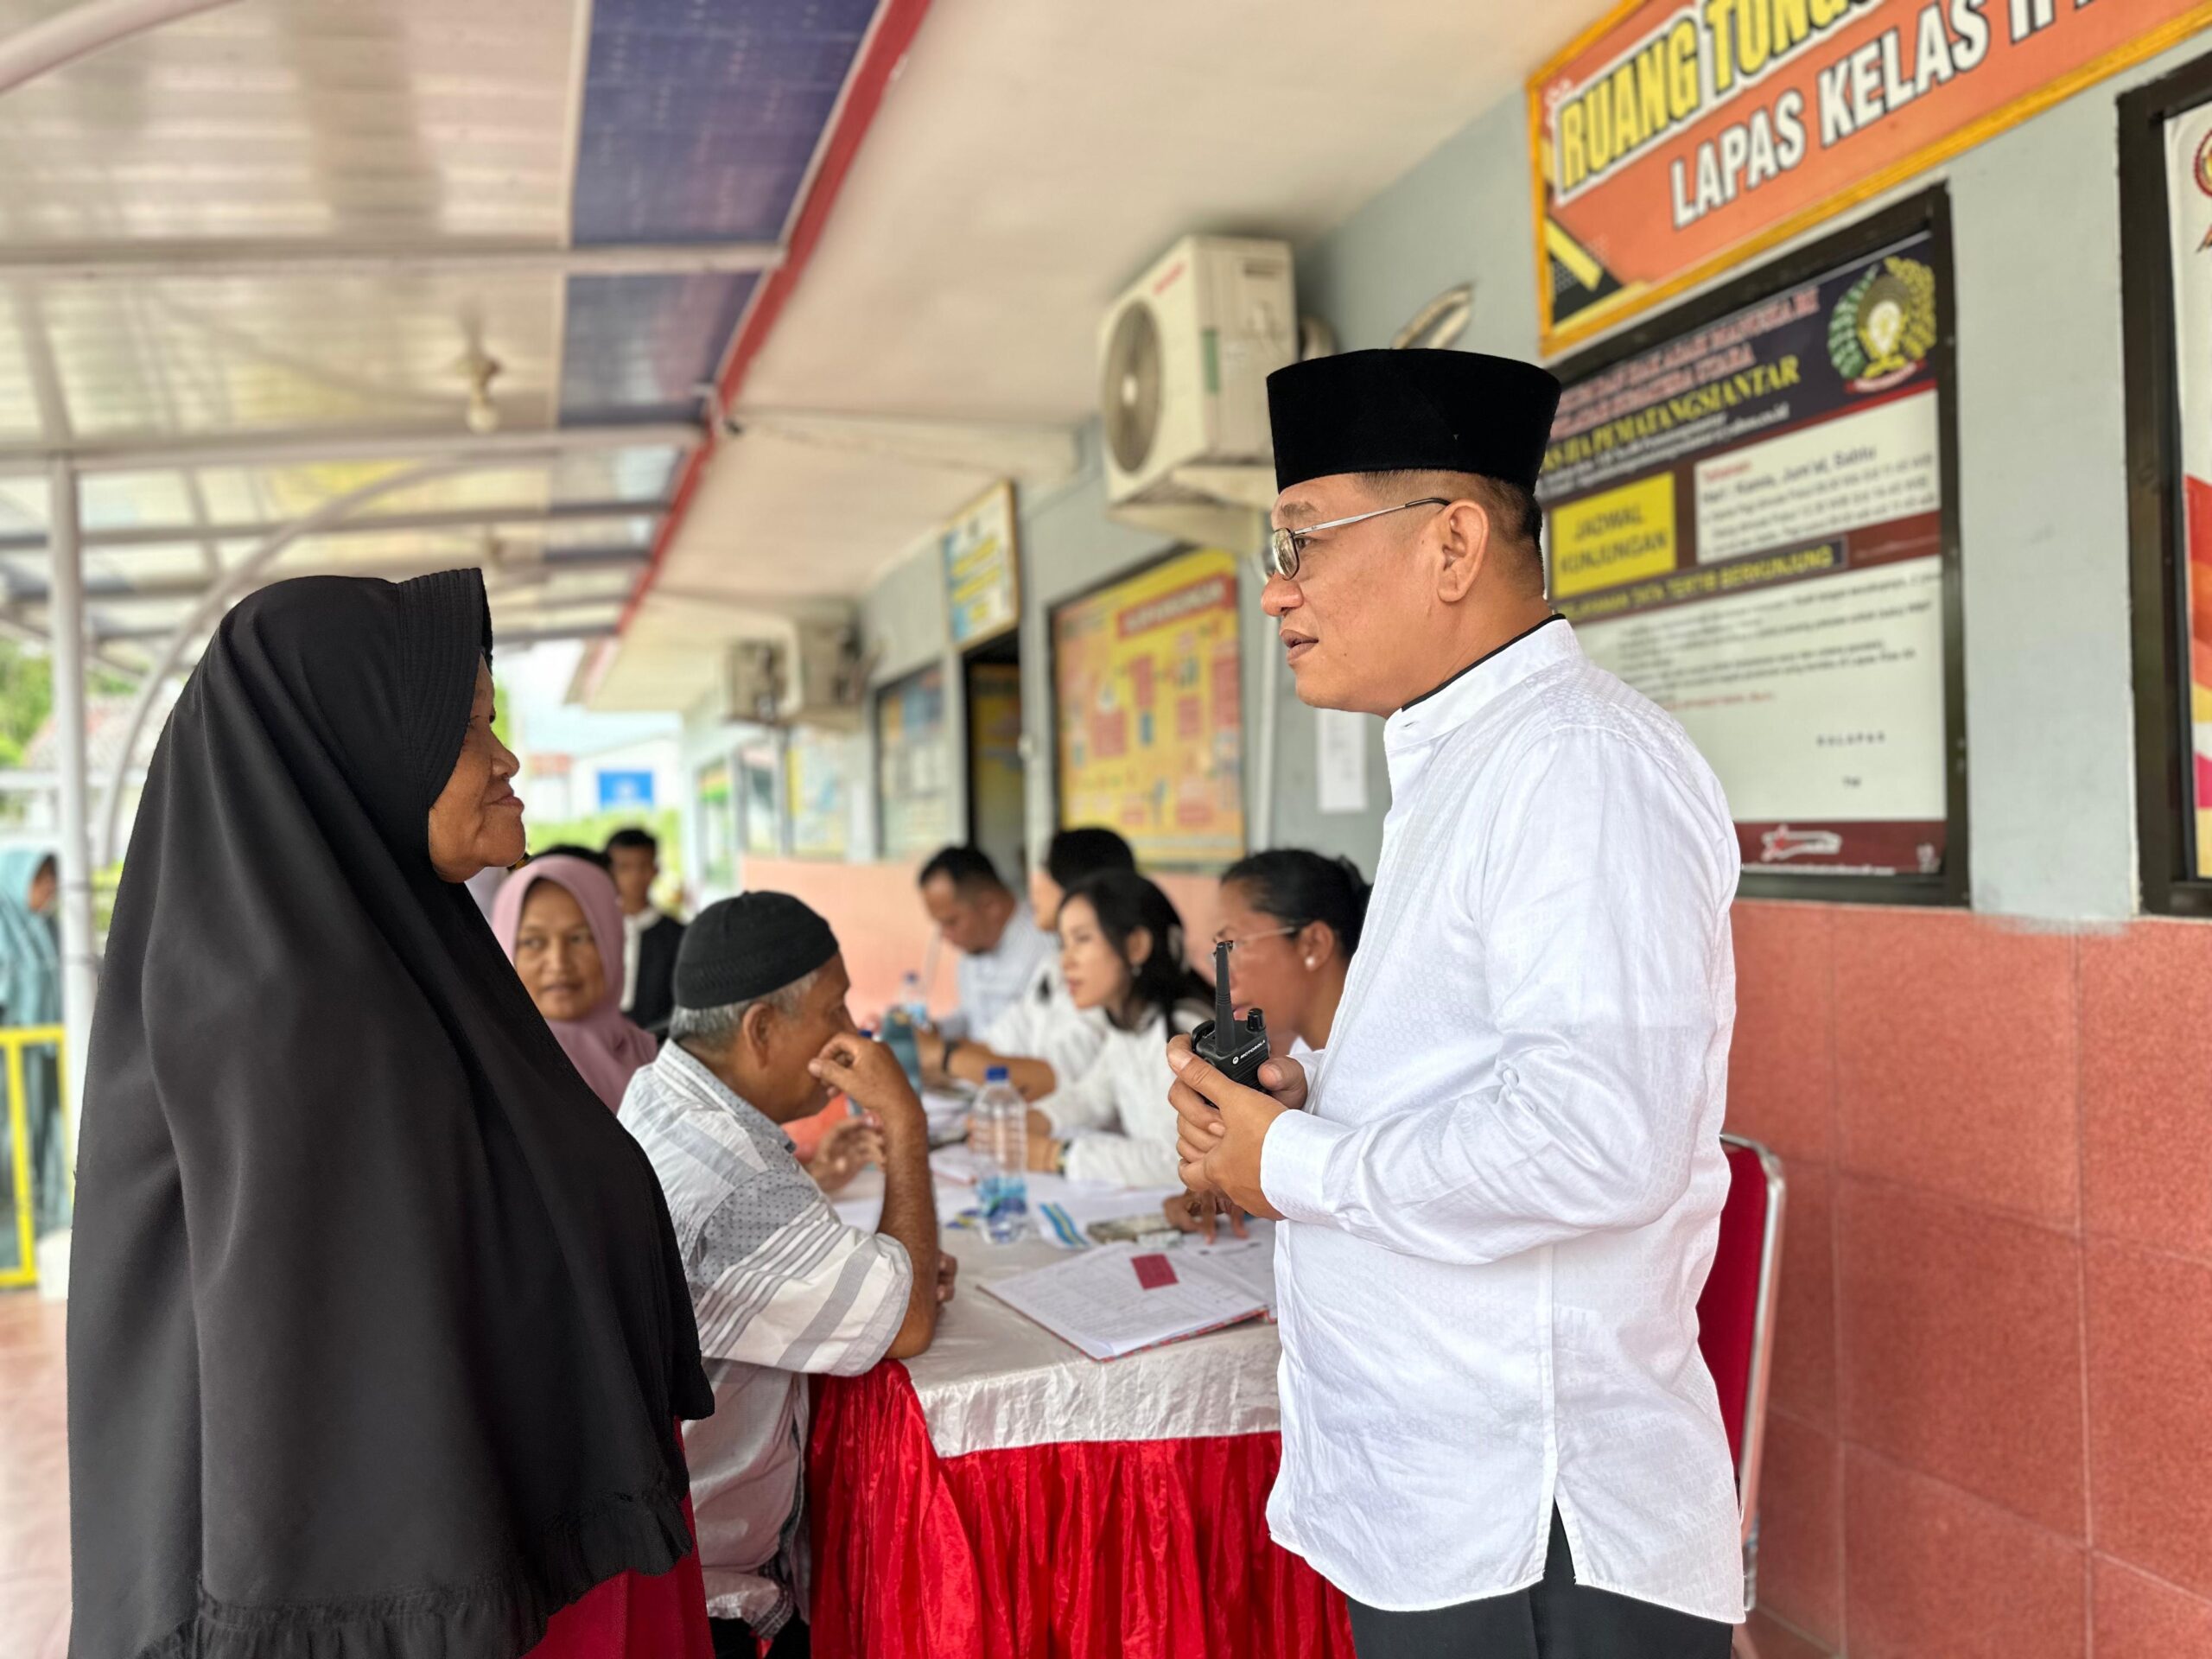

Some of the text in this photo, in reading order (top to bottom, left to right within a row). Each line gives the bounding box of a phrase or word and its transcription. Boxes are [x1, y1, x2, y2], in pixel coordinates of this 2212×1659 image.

[1560, 0, 1851, 193] RUANG TUN
[1672, 89, 1807, 227] LAPAS
[1817, 0, 1990, 149] KELAS
[1573, 505, 1644, 541] JADWAL
[1559, 531, 1668, 575] KUNJUNGAN
[1719, 543, 1834, 590] BERKUNJUNG
[1240, 1039, 1266, 1059] MOTOROLA
